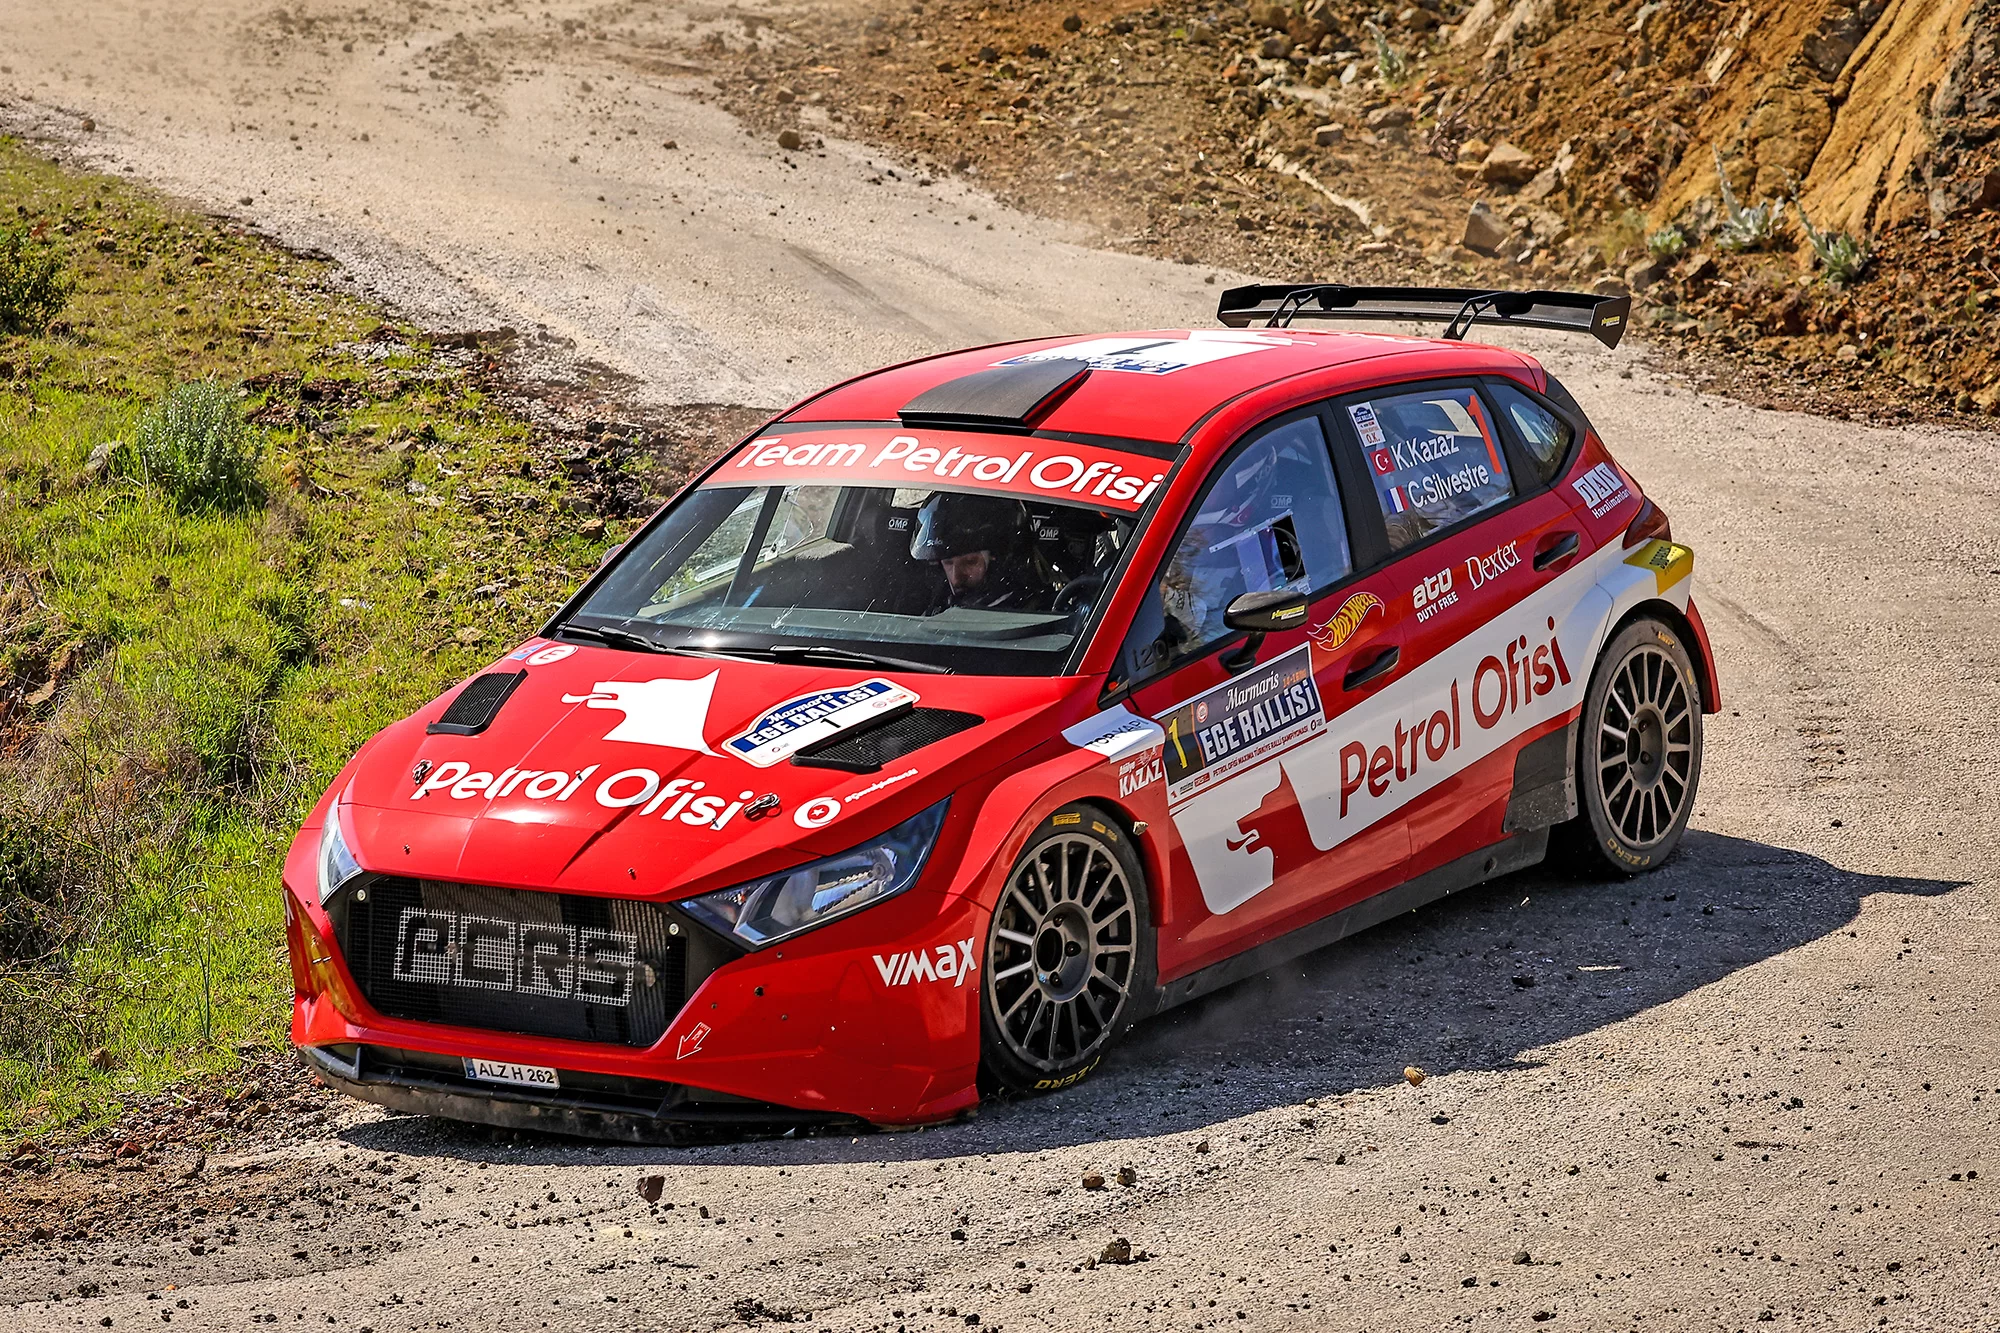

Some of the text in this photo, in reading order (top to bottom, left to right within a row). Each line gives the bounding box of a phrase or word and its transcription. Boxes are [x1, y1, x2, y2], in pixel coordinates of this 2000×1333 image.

[1390, 434, 1460, 471] K.Kazaz
[1466, 395, 1502, 474] 1
[736, 436, 1165, 505] Team Petrol Ofisi
[1407, 463, 1489, 508] C.Silvestre
[888, 518, 908, 529] OMP
[1039, 528, 1059, 538] OMP
[1465, 540, 1522, 591] Dexter
[1416, 591, 1459, 623] DUTY FREE
[766, 692, 834, 724] Marmaris
[1225, 670, 1280, 712] Marmaris
[745, 720, 795, 746] EGE
[820, 717, 841, 729] 1
[1340, 616, 1572, 819] Petrol Ofisi
[1168, 718, 1188, 770] 1
[1199, 719, 1241, 762] EGE
[410, 761, 754, 831] Petrol Ofisi
[1119, 758, 1162, 799] KAZAZ
[396, 908, 636, 1005] PCRS
[478, 1061, 555, 1084] ALZ H 262
[1034, 1065, 1089, 1088] ZERO
